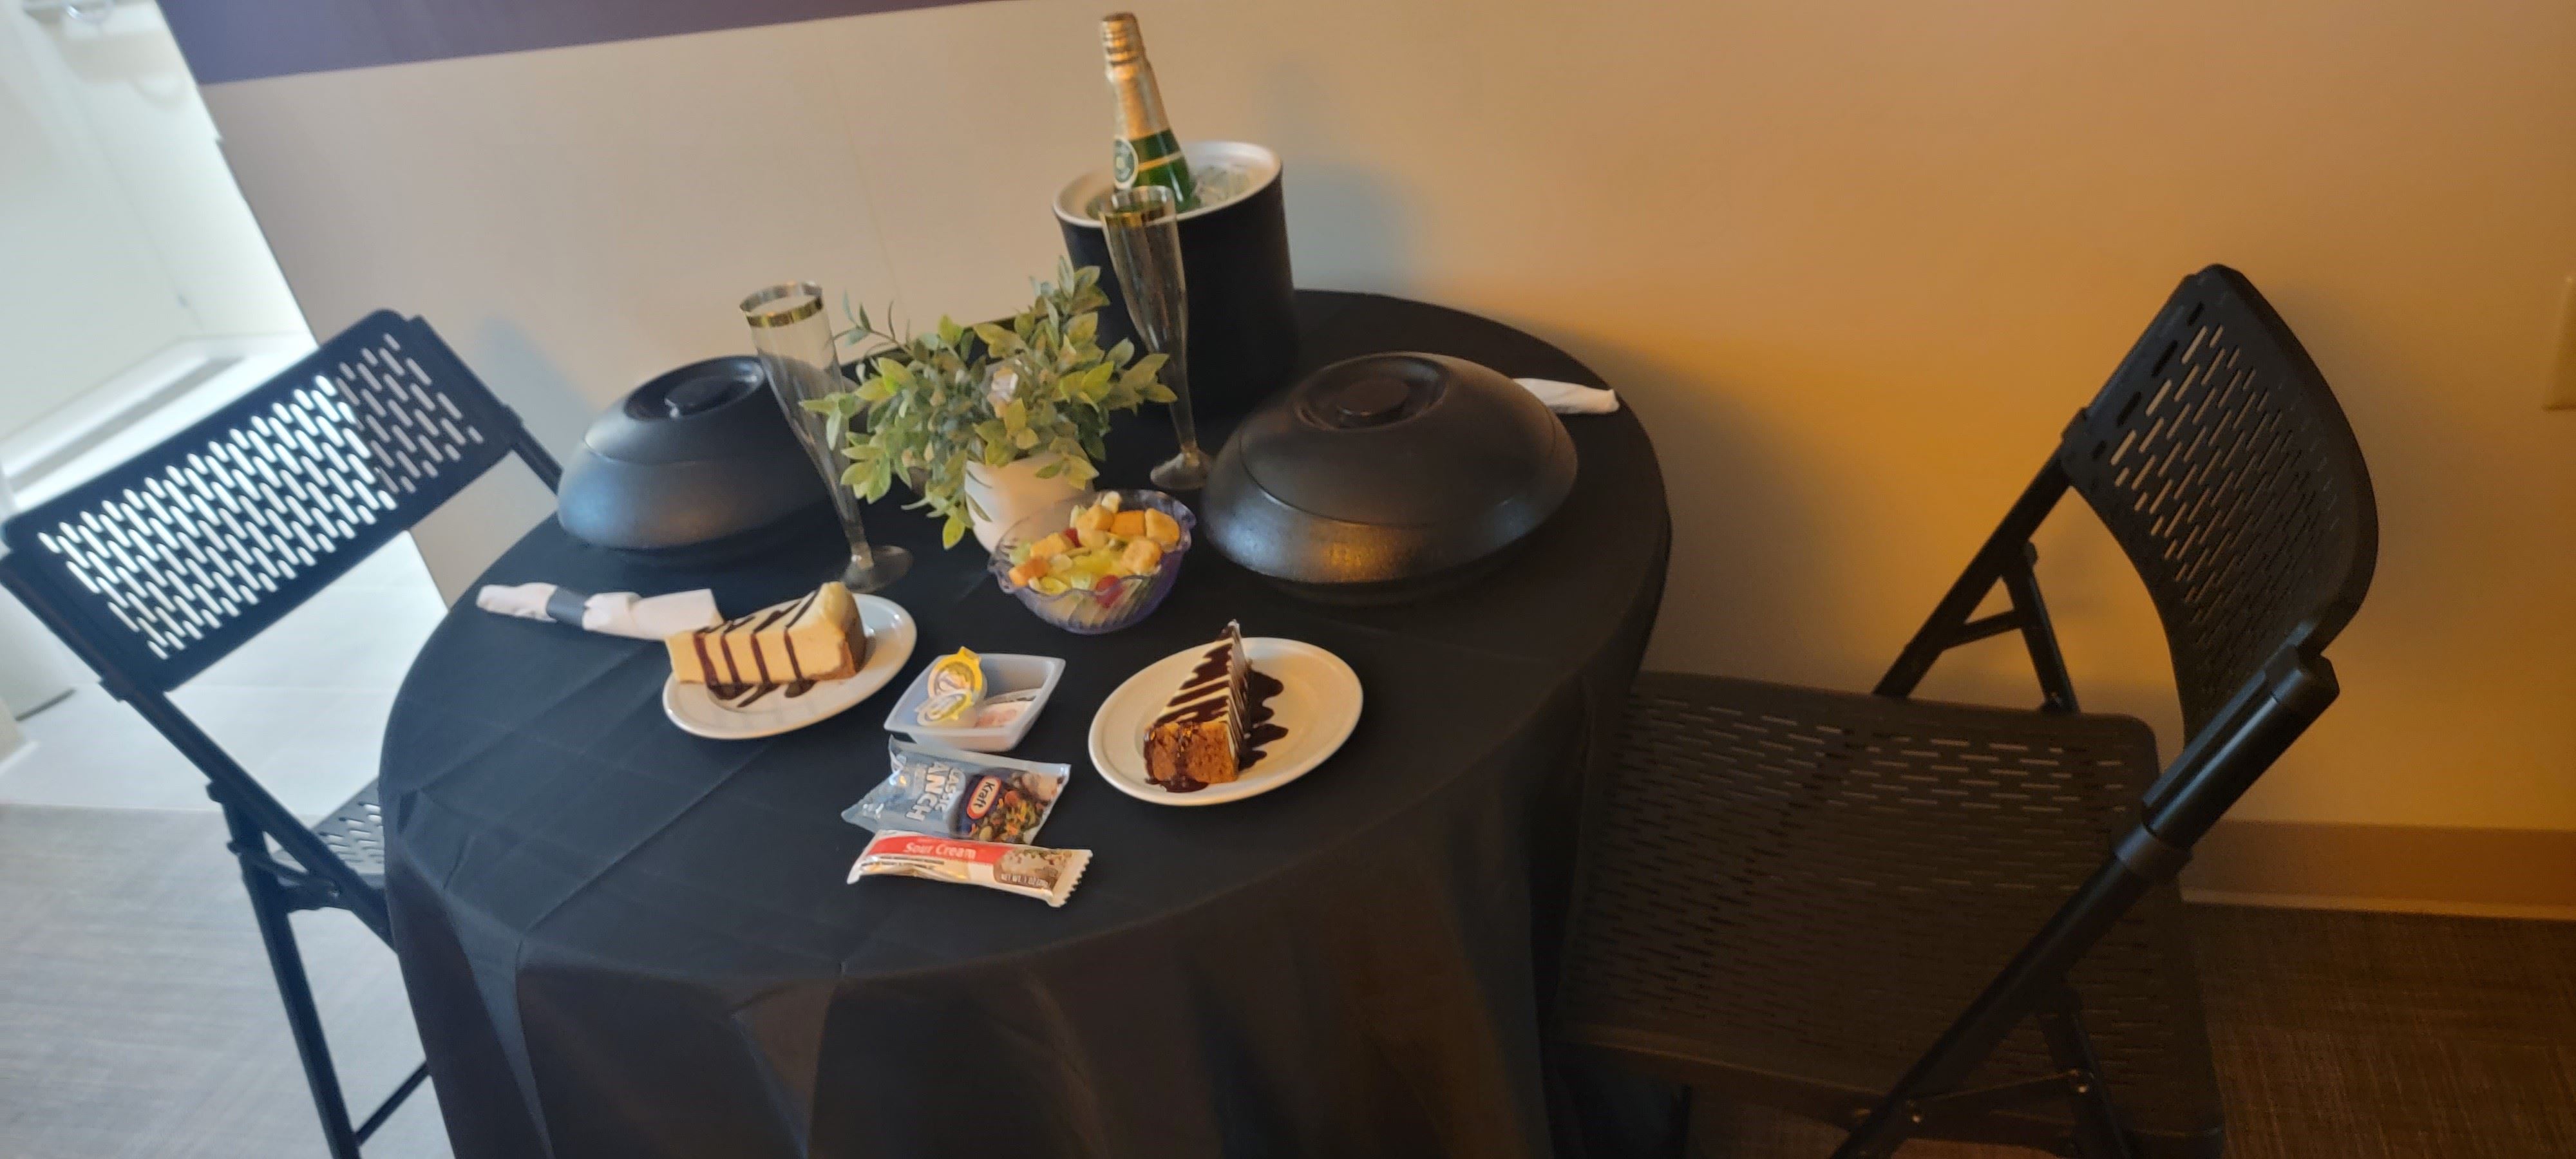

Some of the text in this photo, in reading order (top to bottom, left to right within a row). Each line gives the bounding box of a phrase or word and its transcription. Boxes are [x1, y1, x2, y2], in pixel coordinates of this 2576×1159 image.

[905, 762, 950, 822] ANCH
[934, 768, 960, 812] LASSIC
[973, 782, 995, 808] Kraft
[904, 842, 976, 860] Sour Cream
